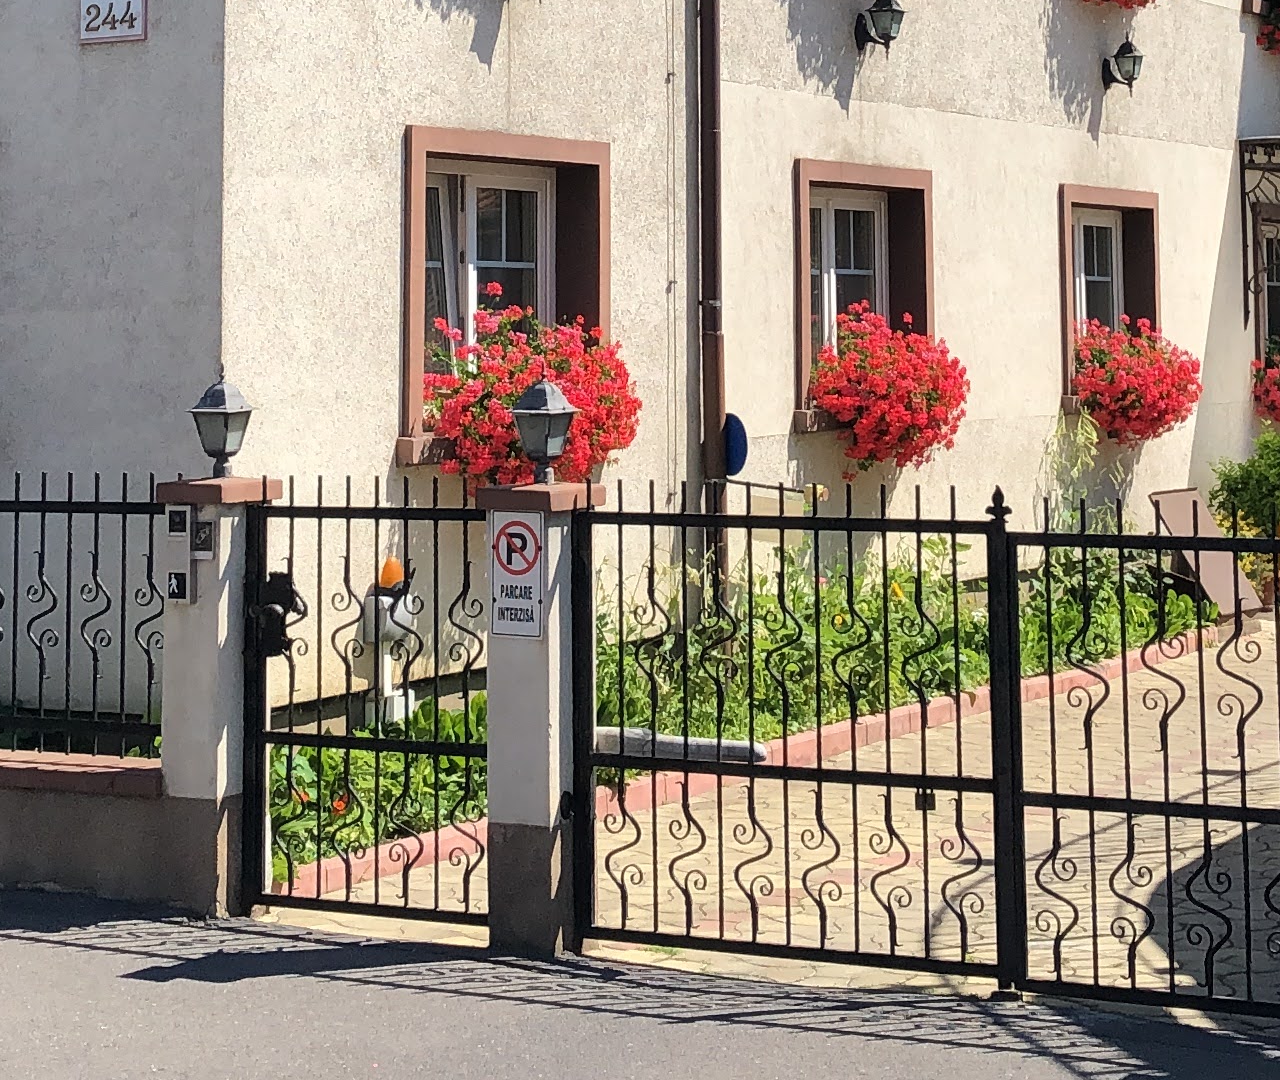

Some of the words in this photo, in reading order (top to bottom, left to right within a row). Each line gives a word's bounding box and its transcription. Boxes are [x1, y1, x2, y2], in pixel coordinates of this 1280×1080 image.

[85, 1, 138, 32] 244
[506, 532, 528, 566] P
[500, 584, 533, 601] PARCARE
